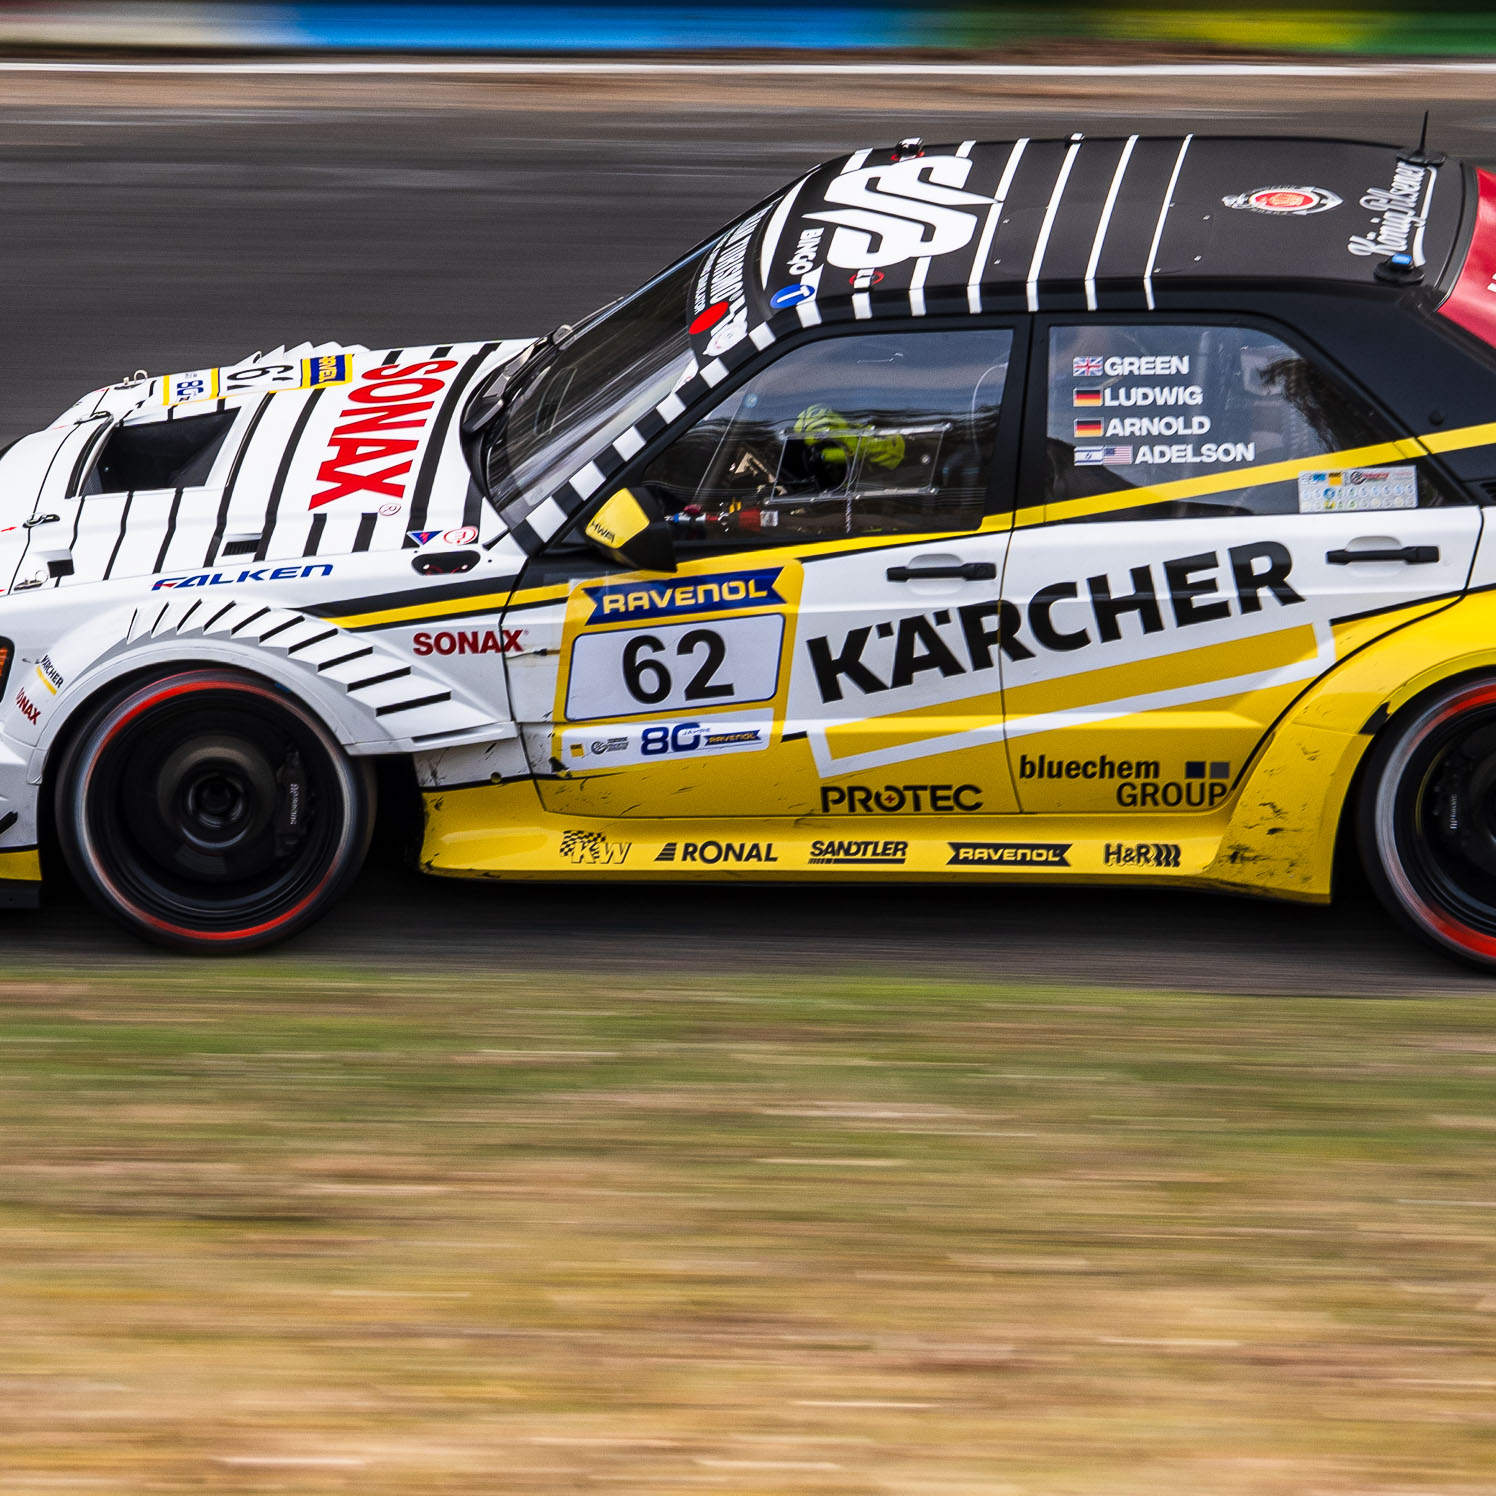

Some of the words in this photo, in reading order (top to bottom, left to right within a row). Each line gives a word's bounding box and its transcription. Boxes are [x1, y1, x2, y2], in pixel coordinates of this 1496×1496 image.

[787, 227, 825, 276] BINGO
[1104, 354, 1191, 377] GREEN
[1104, 385, 1204, 407] LUDWIG
[307, 359, 459, 512] SONAX
[1105, 415, 1212, 438] ARNOLD
[1134, 441, 1256, 465] ADELSON
[590, 520, 616, 544] HWA
[151, 563, 334, 591] FALKEN
[602, 578, 769, 615] RAVENOL
[806, 541, 1307, 705] KÄRCHER
[412, 629, 525, 656] SONAX
[622, 628, 736, 705] 62
[640, 721, 702, 756] 80
[1018, 754, 1161, 780] bluechem
[819, 784, 984, 813] PROTEC
[1115, 781, 1228, 808] GROUP
[681, 839, 779, 865] RONAL
[809, 839, 909, 858] SANDTLER
[958, 847, 1063, 863] RAVENOL
